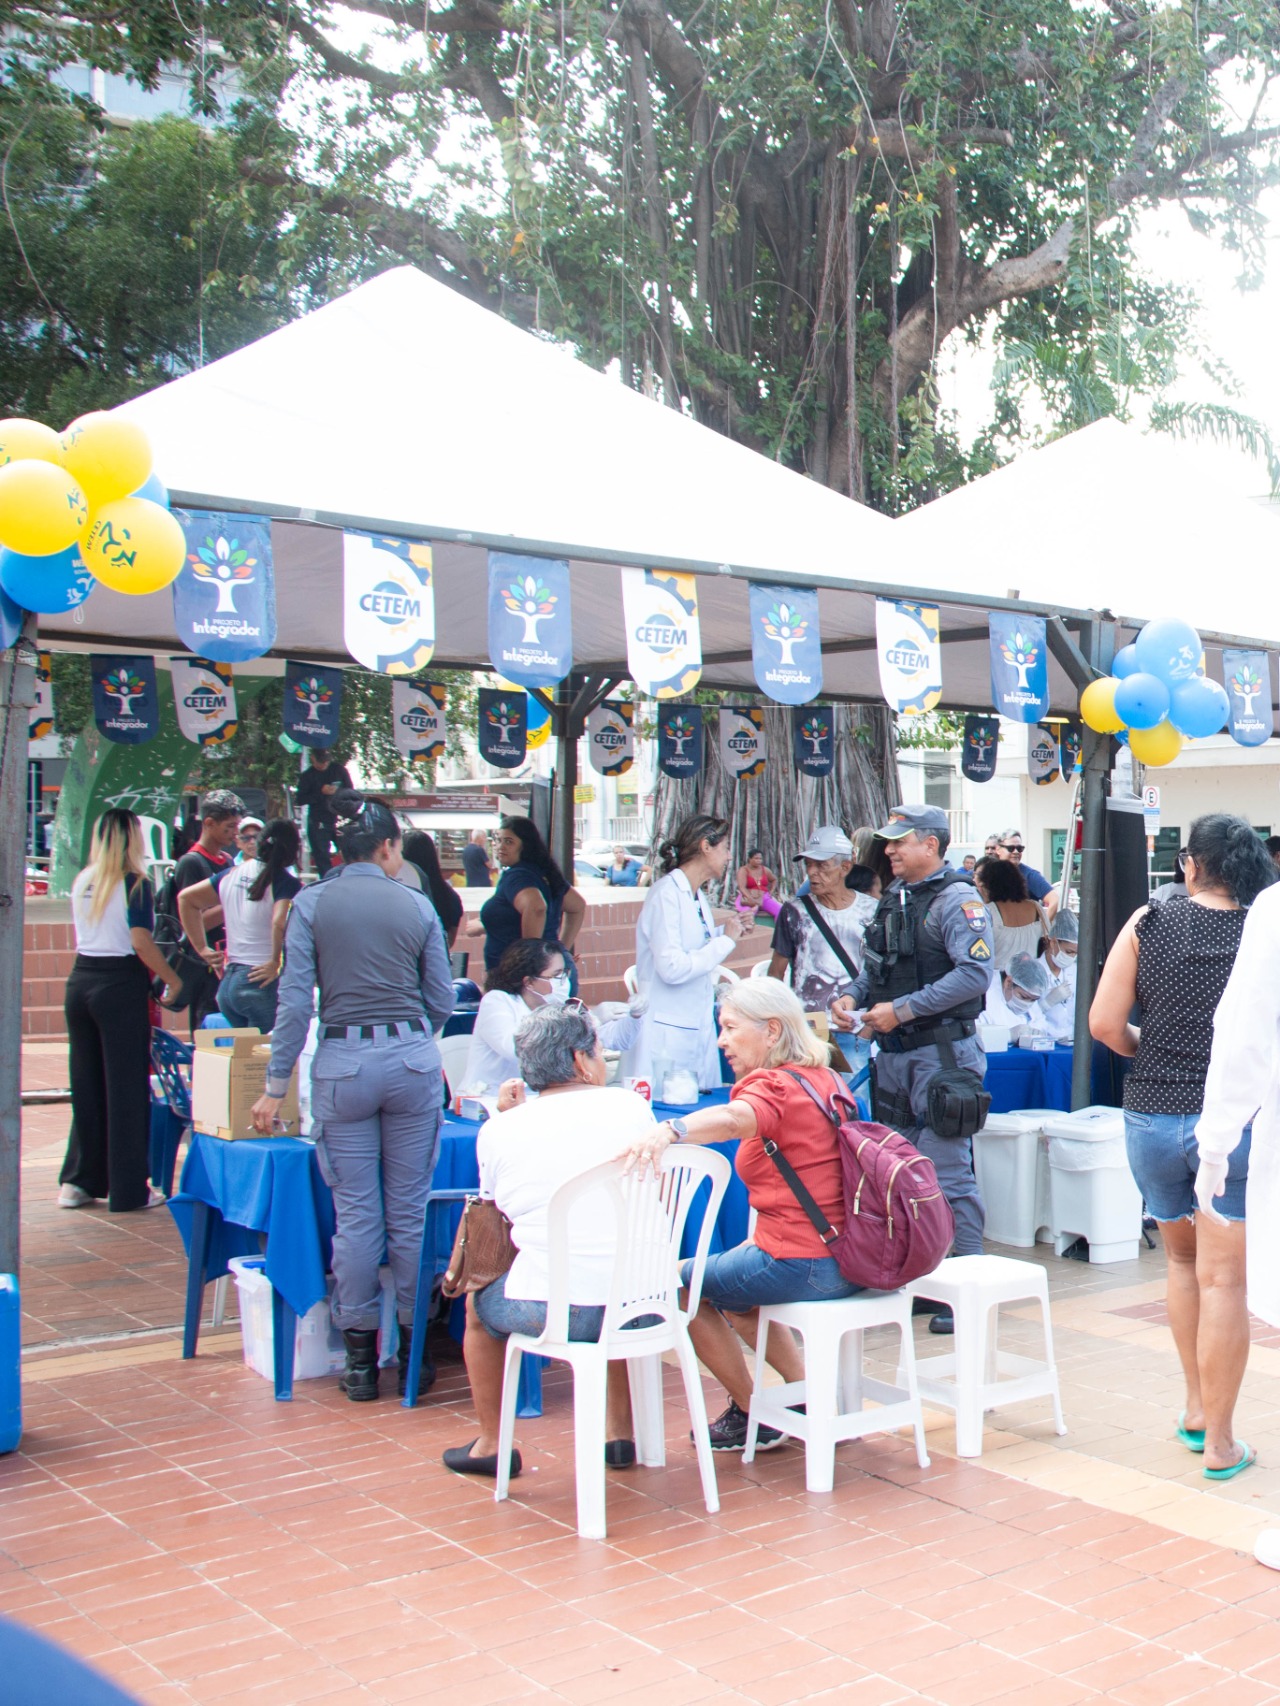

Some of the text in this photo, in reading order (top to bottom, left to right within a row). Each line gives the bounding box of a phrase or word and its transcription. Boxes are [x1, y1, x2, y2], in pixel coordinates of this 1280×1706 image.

[358, 593, 421, 618] CETEM
[192, 618, 260, 639] Integrador
[213, 618, 241, 627] PROJETO
[635, 626, 688, 646] CETEM
[502, 646, 559, 666] Integrador
[885, 649, 930, 670] CETEM
[765, 669, 812, 685] Integrador
[183, 695, 227, 708] CETEM
[1003, 692, 1042, 706] Integrador
[105, 717, 149, 731] Integrador
[401, 713, 438, 729] CETEM
[293, 721, 331, 736] Integrador
[594, 733, 627, 745] CETEM
[727, 738, 758, 749] CETEM
[665, 756, 694, 768] Integrador
[1031, 750, 1055, 760] CETEM
[1149, 791, 1154, 803] E
